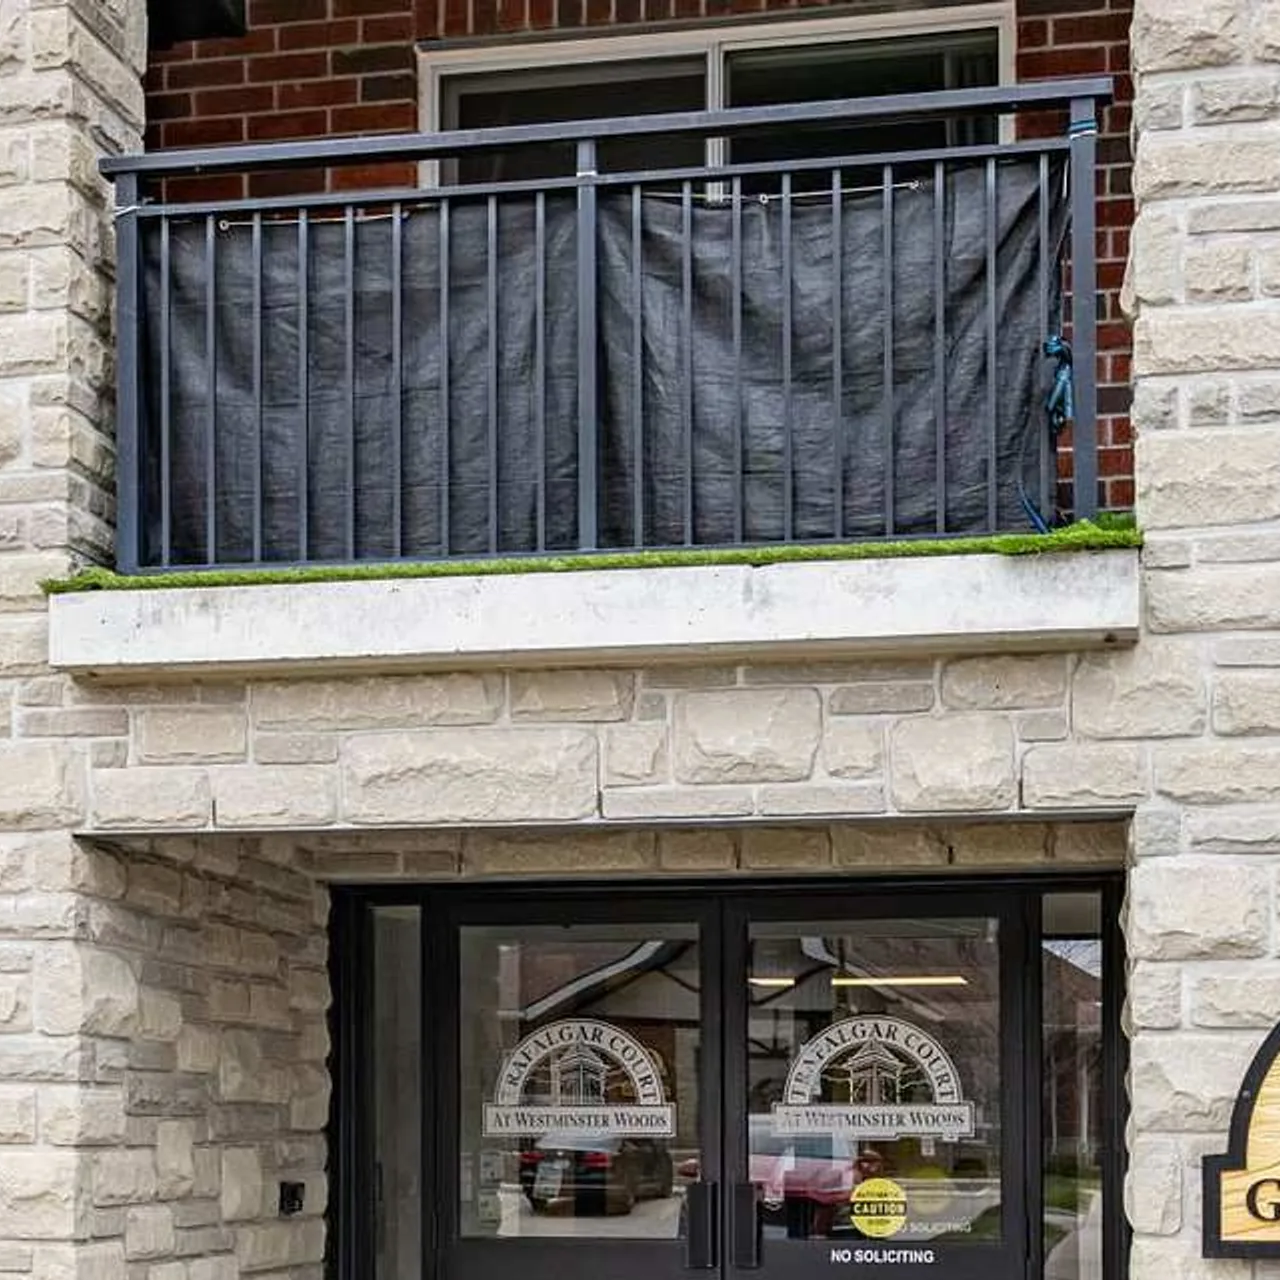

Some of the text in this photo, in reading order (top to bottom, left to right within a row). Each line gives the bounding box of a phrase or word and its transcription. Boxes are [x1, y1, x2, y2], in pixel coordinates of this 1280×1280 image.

[503, 1026, 658, 1100] RAFALGAR COURT
[904, 1034, 956, 1099] COURT
[853, 1202, 906, 1215] CAUTION
[831, 1249, 936, 1264] NO SOLICITING
